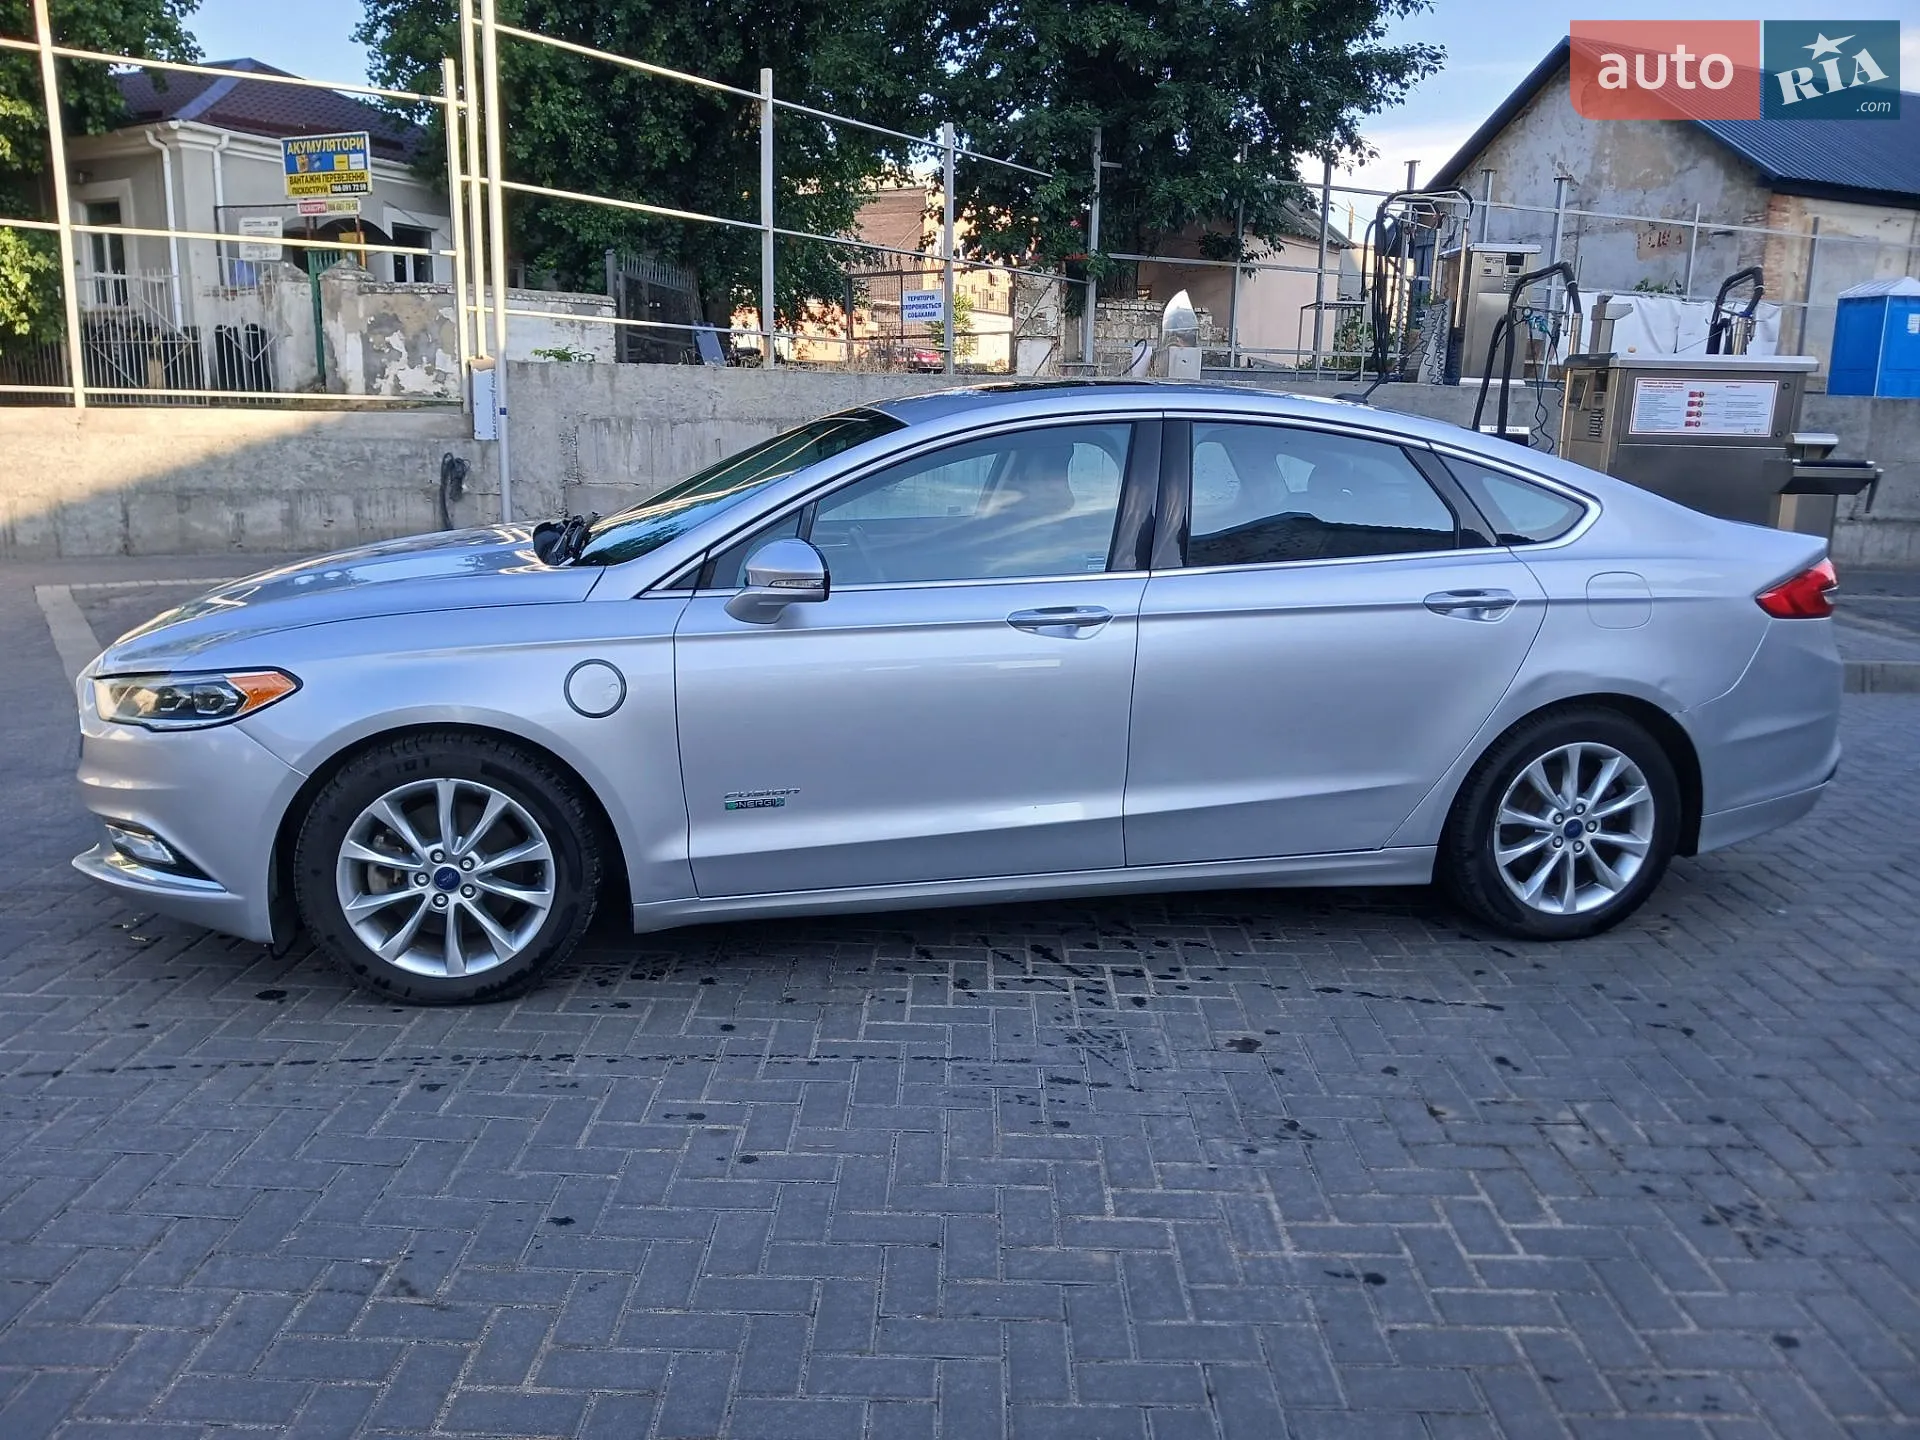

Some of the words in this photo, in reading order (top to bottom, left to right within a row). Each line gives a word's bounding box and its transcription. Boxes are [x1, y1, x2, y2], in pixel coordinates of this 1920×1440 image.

[287, 137, 364, 155] АКУМУЛЯТОРИ
[289, 174, 321, 185] ВАНТАЖНІ
[322, 172, 365, 183] ПЕРЕВЕЗЕННЯ
